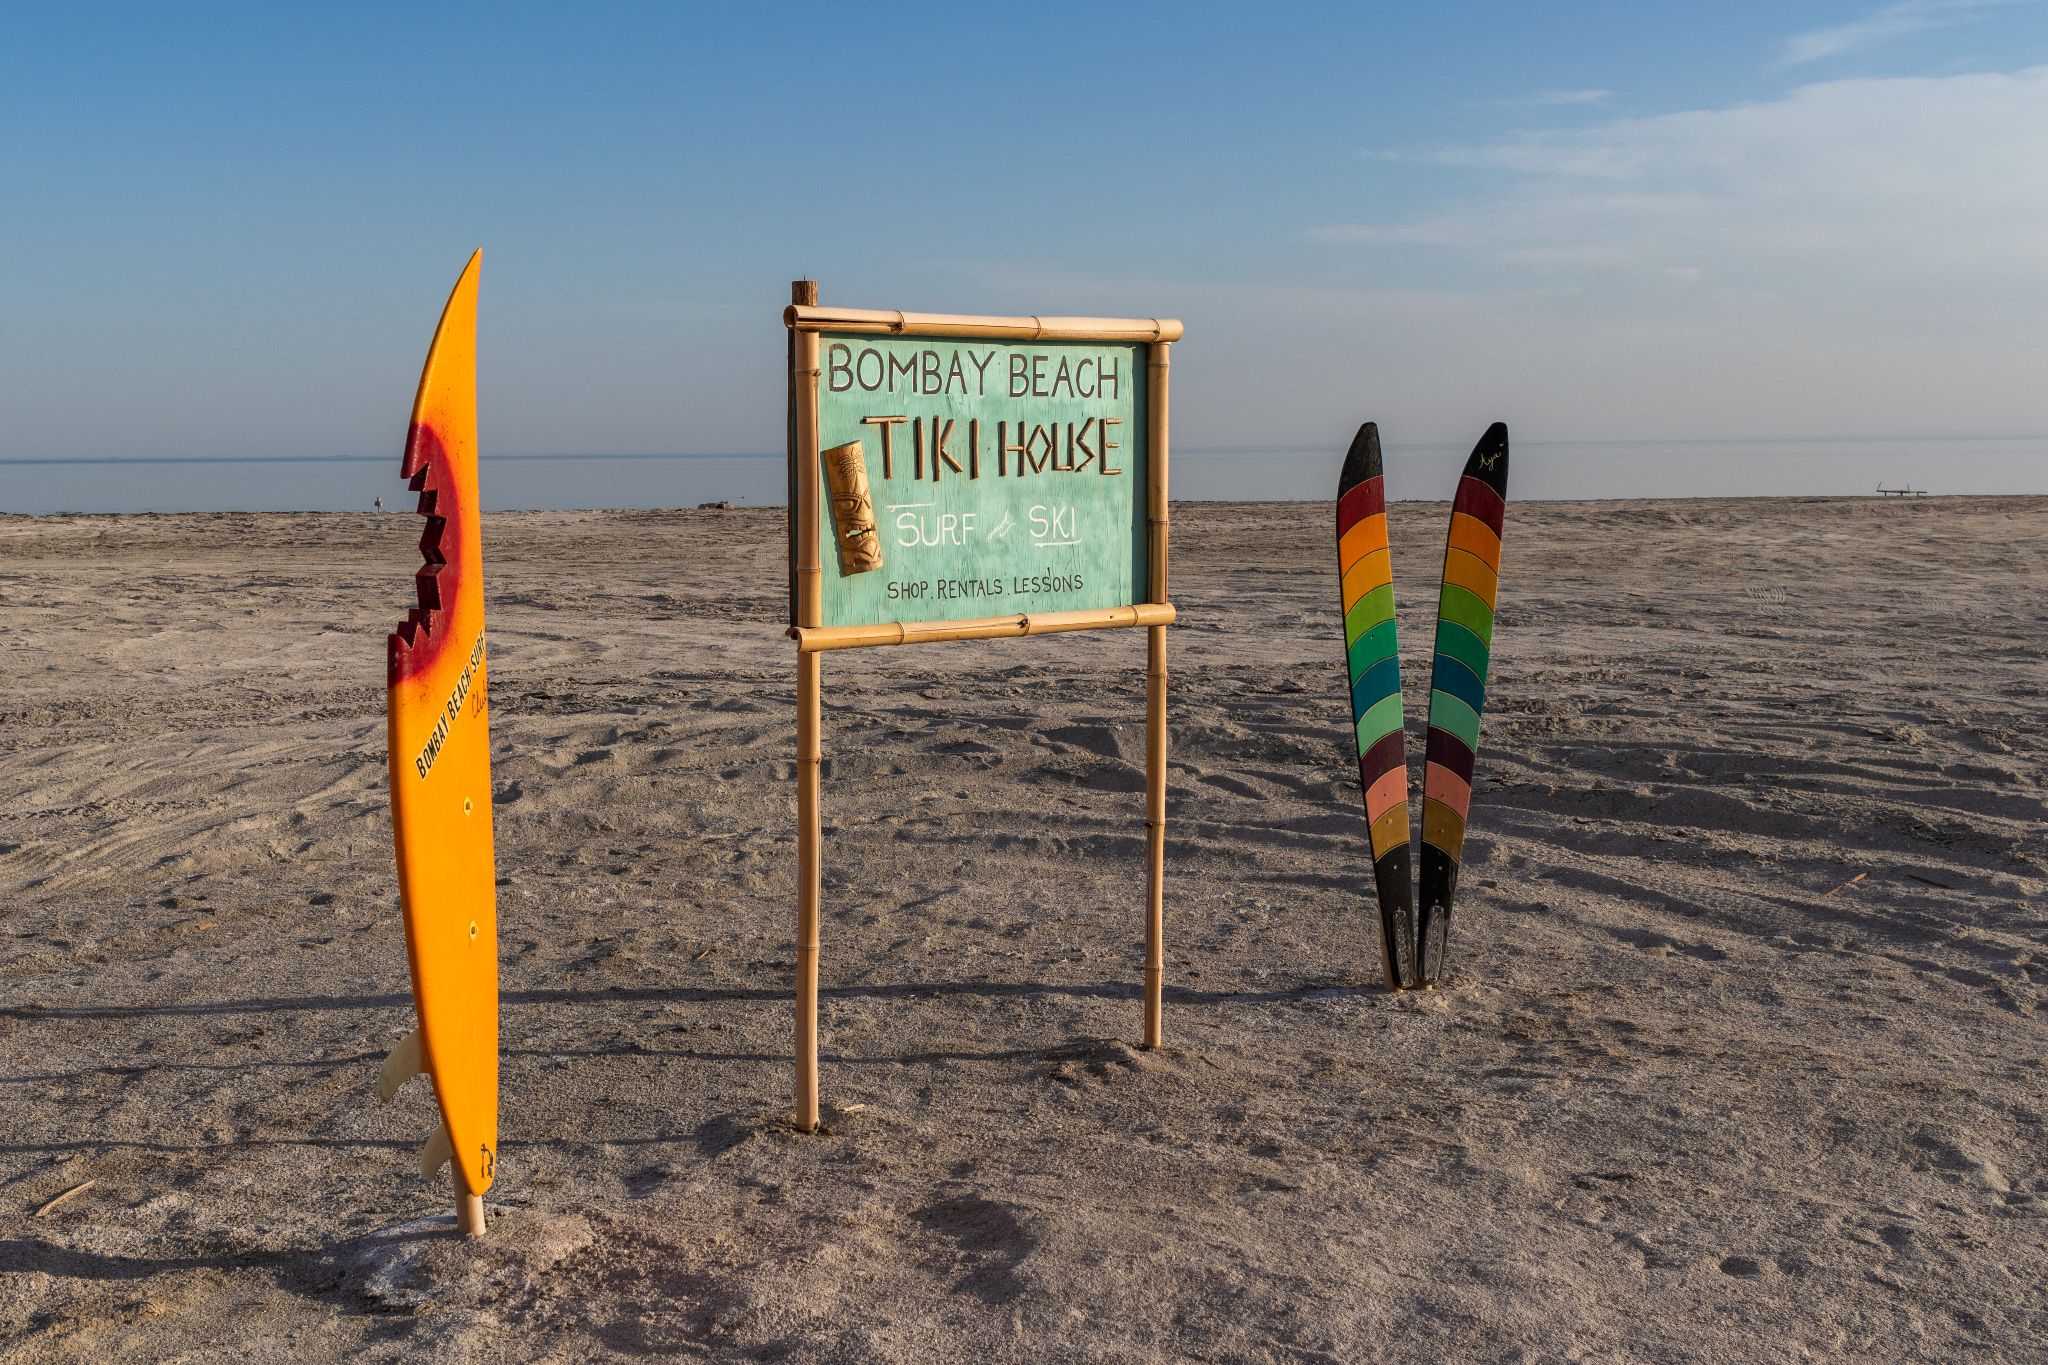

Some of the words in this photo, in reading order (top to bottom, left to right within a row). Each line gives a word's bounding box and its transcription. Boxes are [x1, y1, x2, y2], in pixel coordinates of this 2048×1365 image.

[828, 343, 996, 396] BOMBAY
[1008, 353, 1119, 400] BEACH
[860, 415, 980, 482] TIKI
[998, 417, 1123, 477] HOUSE
[896, 512, 976, 547] SURF
[1029, 505, 1076, 540] SKI
[1014, 574, 1084, 595] LESSONS
[416, 711, 449, 779] BOMBAY
[446, 665, 472, 721] BEACH
[470, 629, 485, 674] SURF
